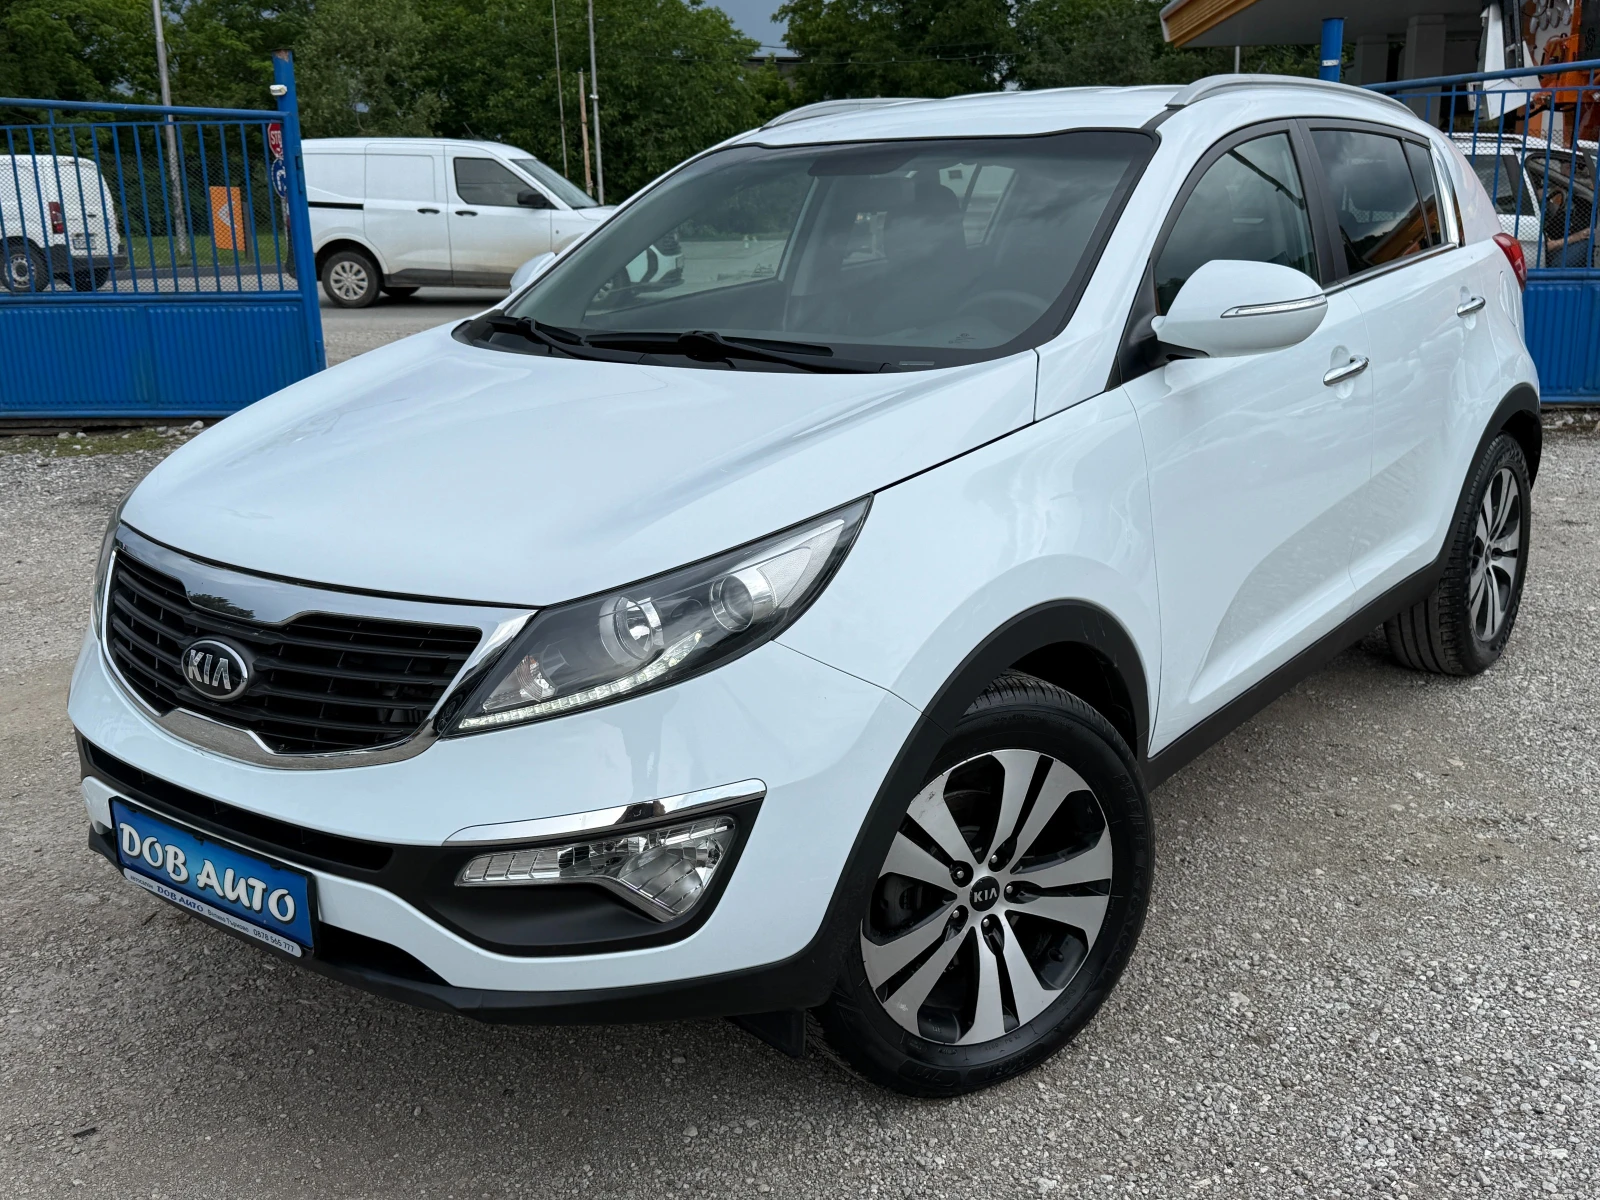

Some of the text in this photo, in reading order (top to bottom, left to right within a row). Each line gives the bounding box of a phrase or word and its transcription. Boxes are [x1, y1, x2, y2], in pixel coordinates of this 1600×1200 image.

[188, 649, 231, 690] KIA
[119, 822, 296, 923] DOB AUTO
[973, 887, 998, 904] KIA
[157, 885, 177, 901] DOB
[178, 897, 204, 913] AUTO
[253, 928, 269, 941] 0878
[283, 942, 295, 953] 777
